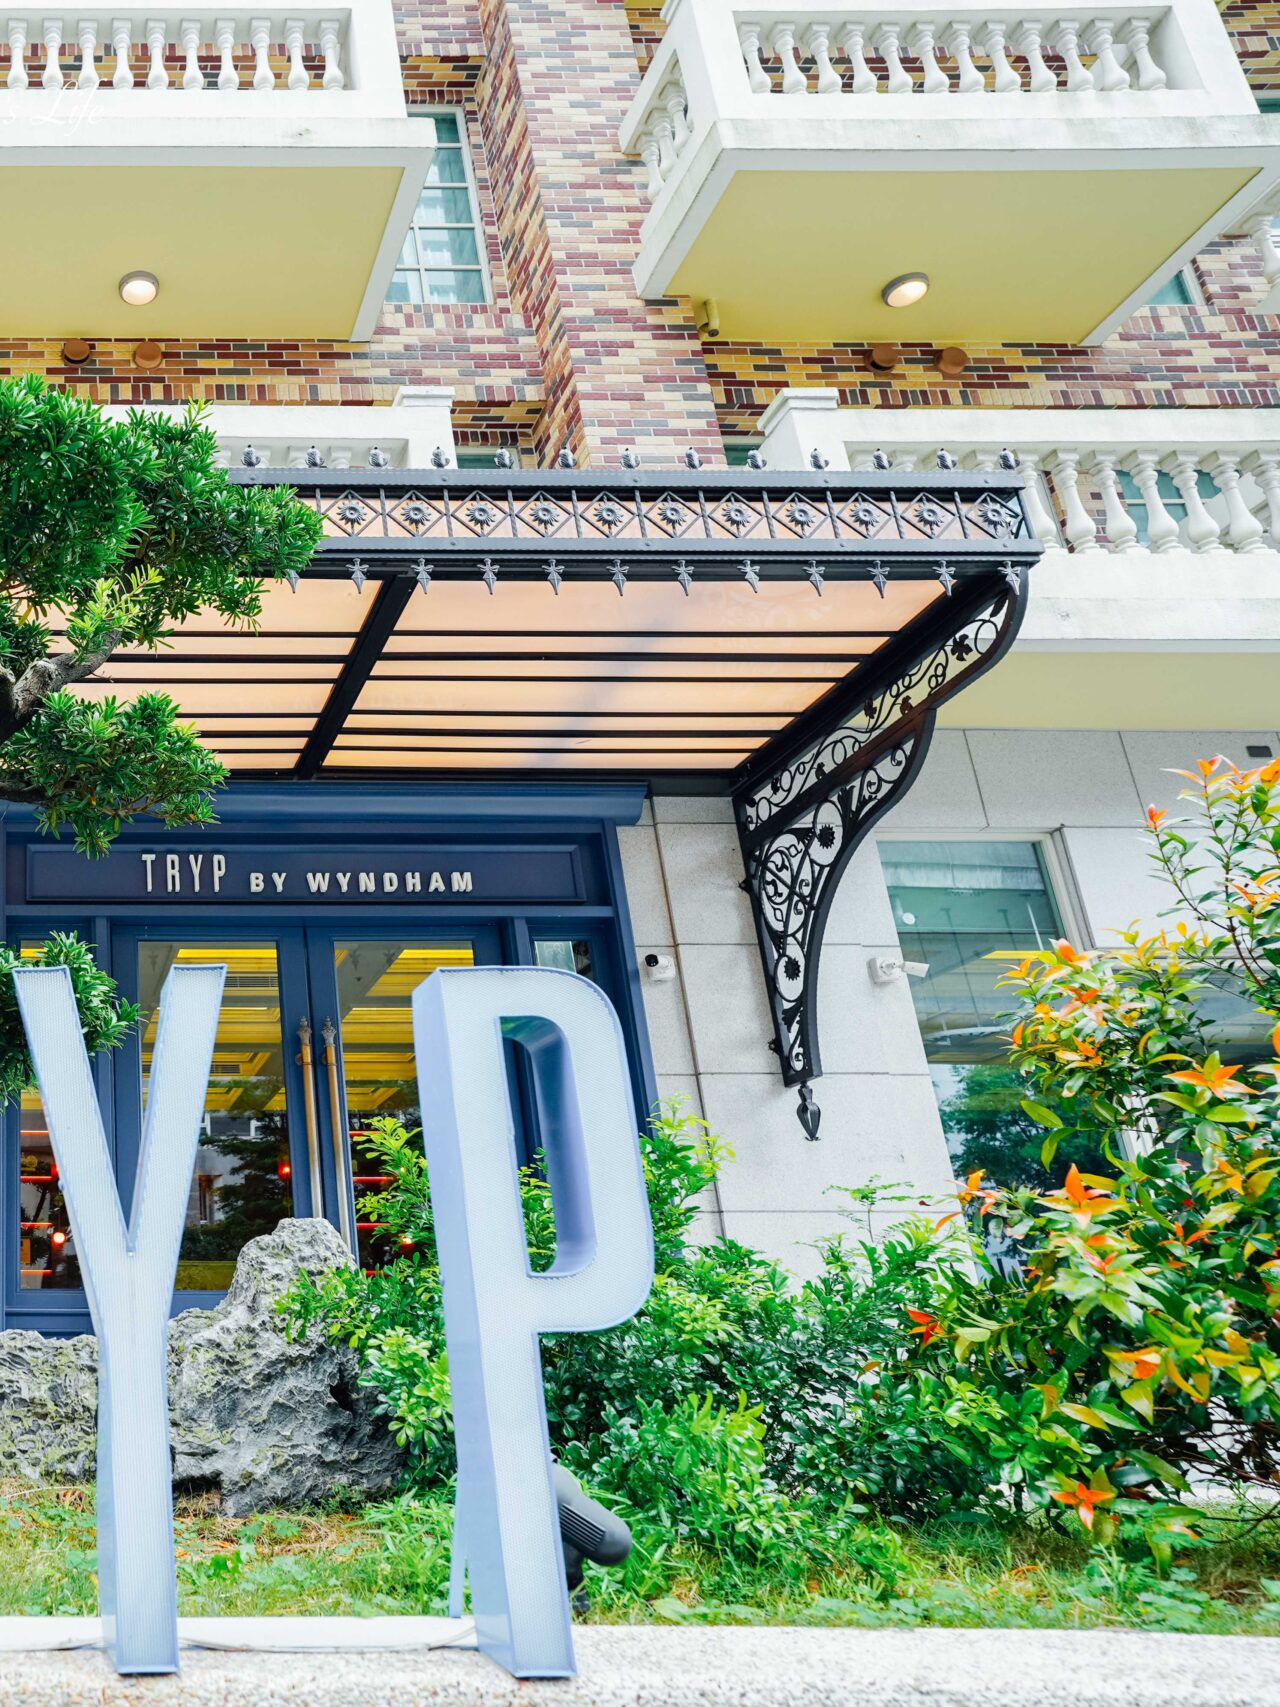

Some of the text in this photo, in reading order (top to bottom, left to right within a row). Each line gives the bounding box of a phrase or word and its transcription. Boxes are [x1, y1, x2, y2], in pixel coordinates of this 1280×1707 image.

[141, 853, 474, 893] TRYP BY WYNDHAM
